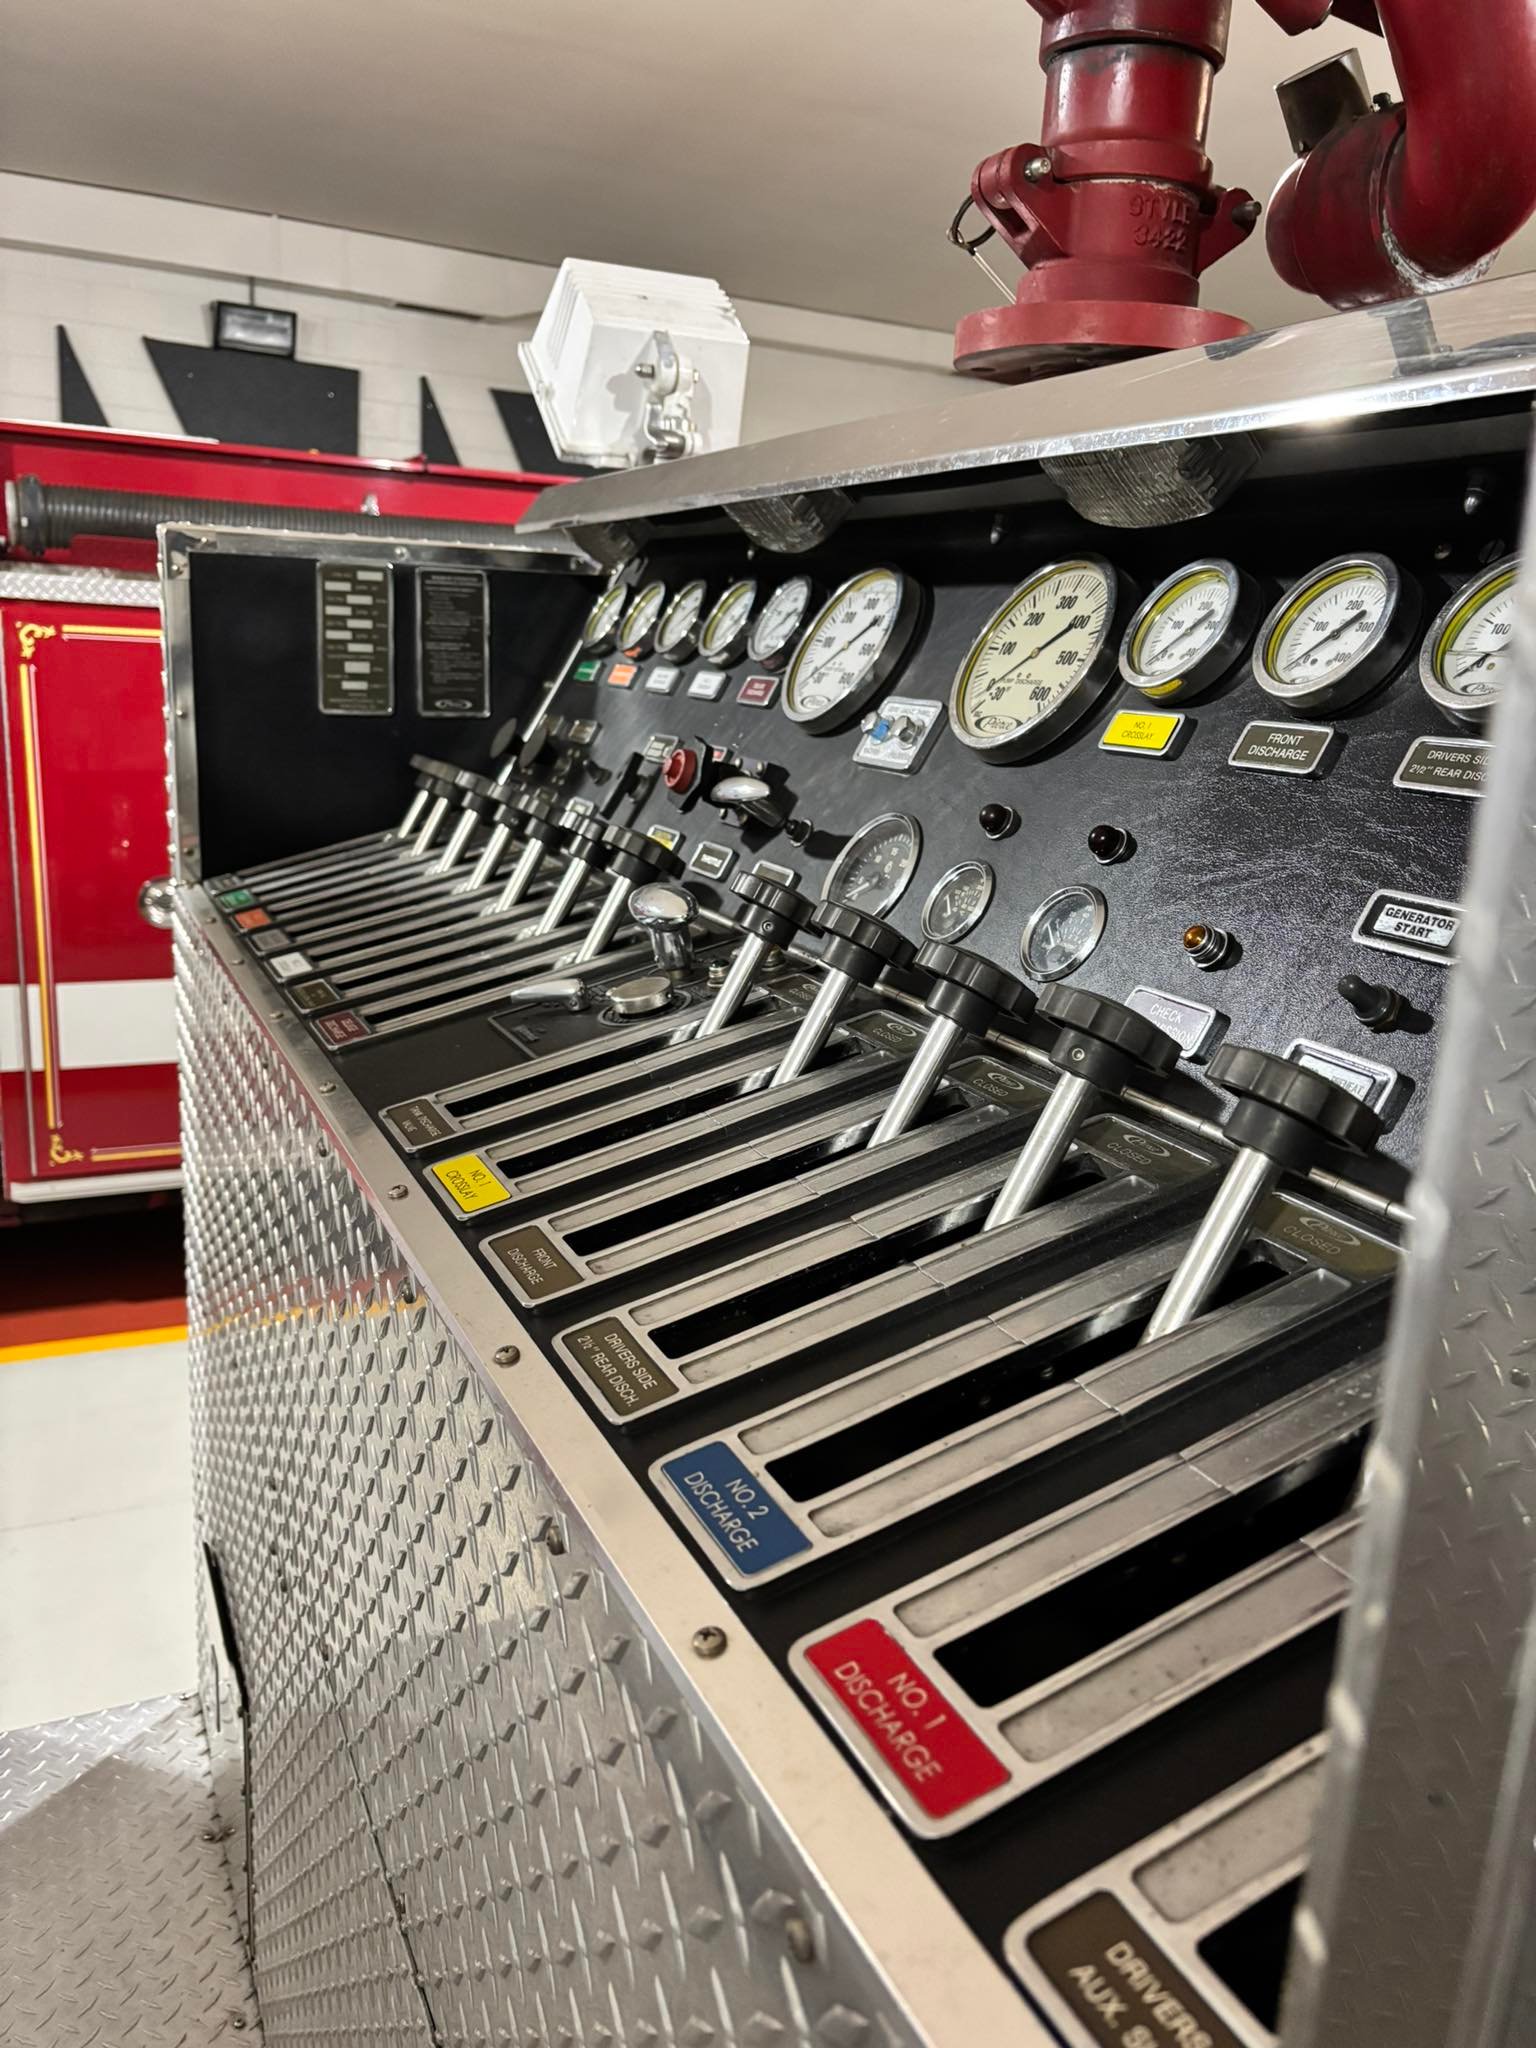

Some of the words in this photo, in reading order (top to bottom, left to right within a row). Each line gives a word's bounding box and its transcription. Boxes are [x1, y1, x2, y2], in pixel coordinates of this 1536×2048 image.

[1129, 193, 1190, 224] STYLE
[1056, 596, 1078, 610] 300
[1345, 600, 1364, 610] 200
[1023, 612, 1045, 626] 200
[1071, 615, 1091, 629] 400
[1312, 621, 1329, 632] 100
[1355, 621, 1375, 632] 300
[1490, 623, 1511, 635] 100
[998, 641, 1017, 655] 100
[1055, 651, 1078, 665] 500
[1029, 686, 1051, 701] 600
[1121, 730, 1154, 741] CROSSLAY
[1266, 733, 1303, 746] FRONT
[1247, 745, 1309, 761] DISCHARGE
[1427, 750, 1471, 764] DRIVERS
[1433, 766, 1462, 779] REAR
[1463, 769, 1487, 782] DISC
[1385, 907, 1455, 931] GENERATOR
[1394, 922, 1433, 938] START
[1150, 1003, 1185, 1024] CHECK
[1106, 1142, 1152, 1165] CLOSED
[470, 1169, 486, 1183] NO.
[445, 1169, 479, 1200] CROSSLAY
[1283, 1225, 1341, 1255] CLOSED
[532, 1247, 557, 1270] FRONT
[506, 1247, 545, 1287] DISCHARGE
[604, 1332, 641, 1371] DRIVERS
[632, 1366, 657, 1389] SIDE
[590, 1351, 615, 1378] REAR
[608, 1374, 641, 1407] DISCH.
[725, 1477, 758, 1511] NO.
[748, 1503, 769, 1520] 2
[683, 1471, 759, 1554] DISCHARGE
[886, 1671, 929, 1719] NO.
[923, 1713, 947, 1731] 1
[834, 1661, 943, 1782] DISCHARGE
[1067, 1964, 1128, 2030] AUX.
[1104, 1939, 1214, 2048] DRIVERS
